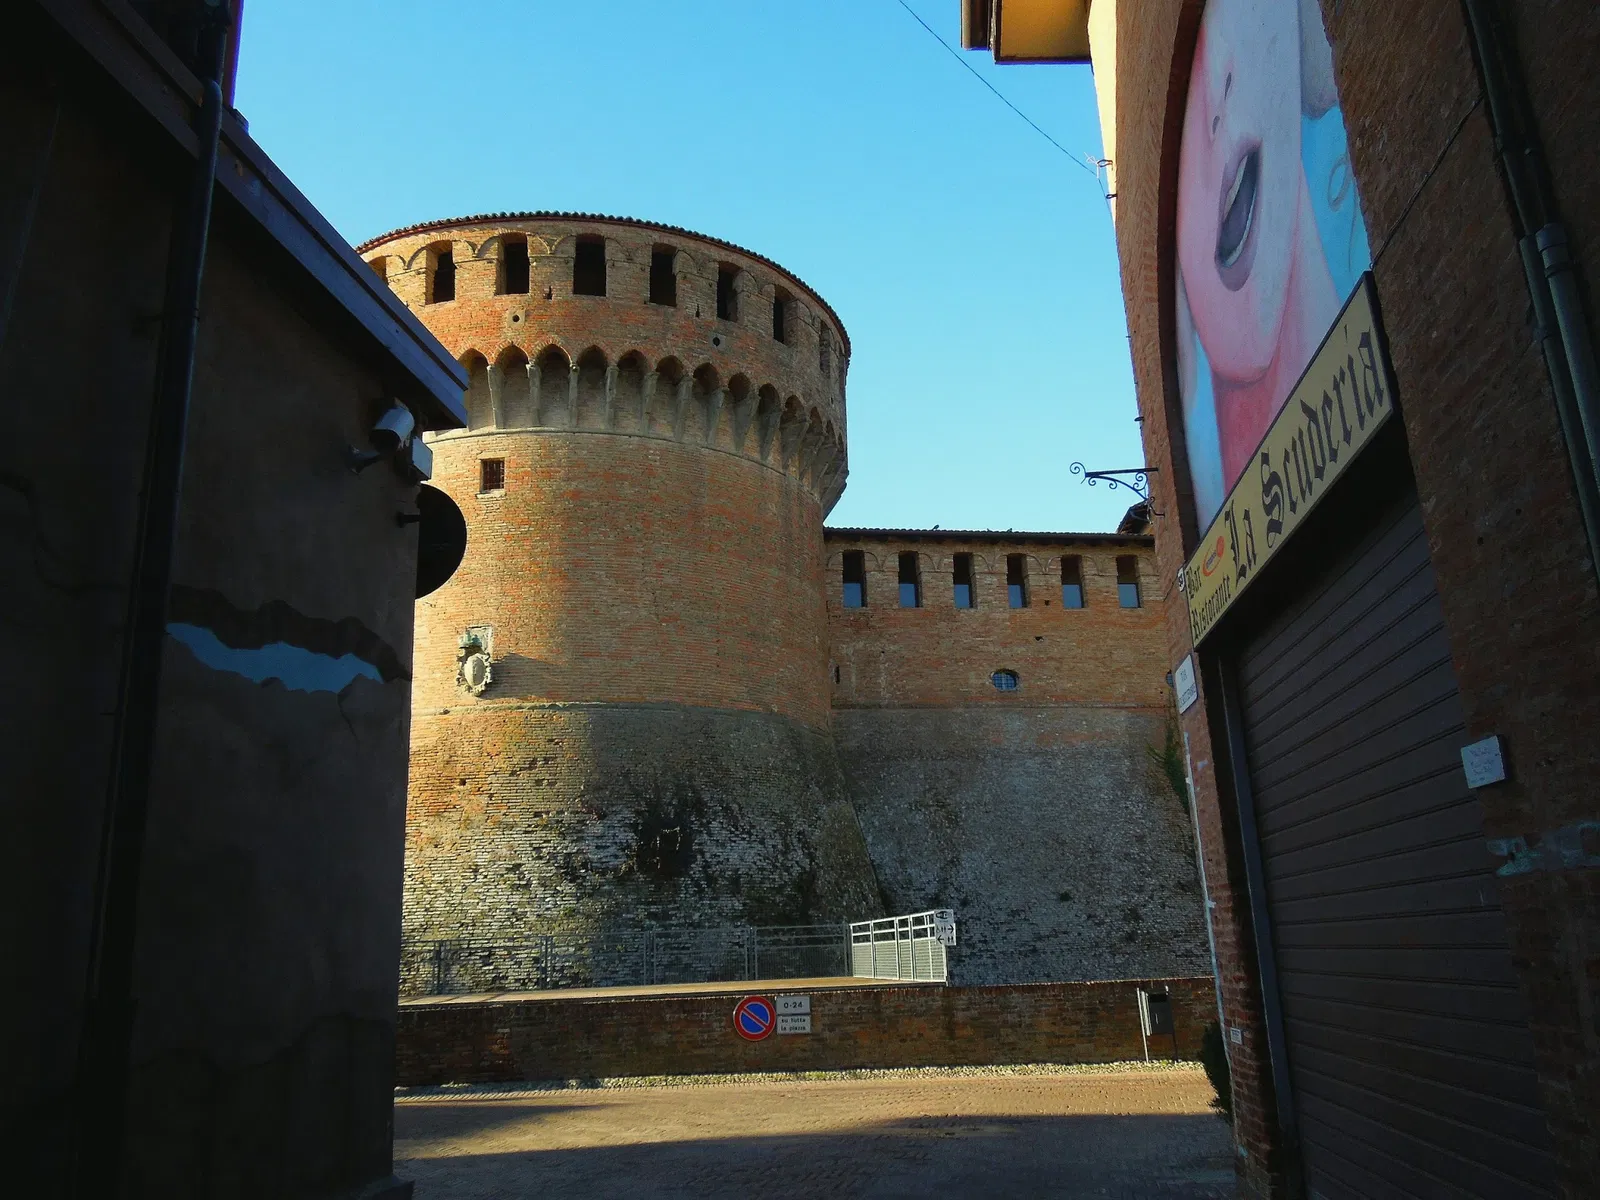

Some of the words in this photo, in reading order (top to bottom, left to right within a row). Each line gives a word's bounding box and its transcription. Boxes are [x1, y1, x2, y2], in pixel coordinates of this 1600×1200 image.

[1225, 499, 1257, 588] La
[1260, 324, 1384, 549] Scuderia
[1186, 566, 1202, 600] Bar
[1191, 574, 1231, 640] Ristorante
